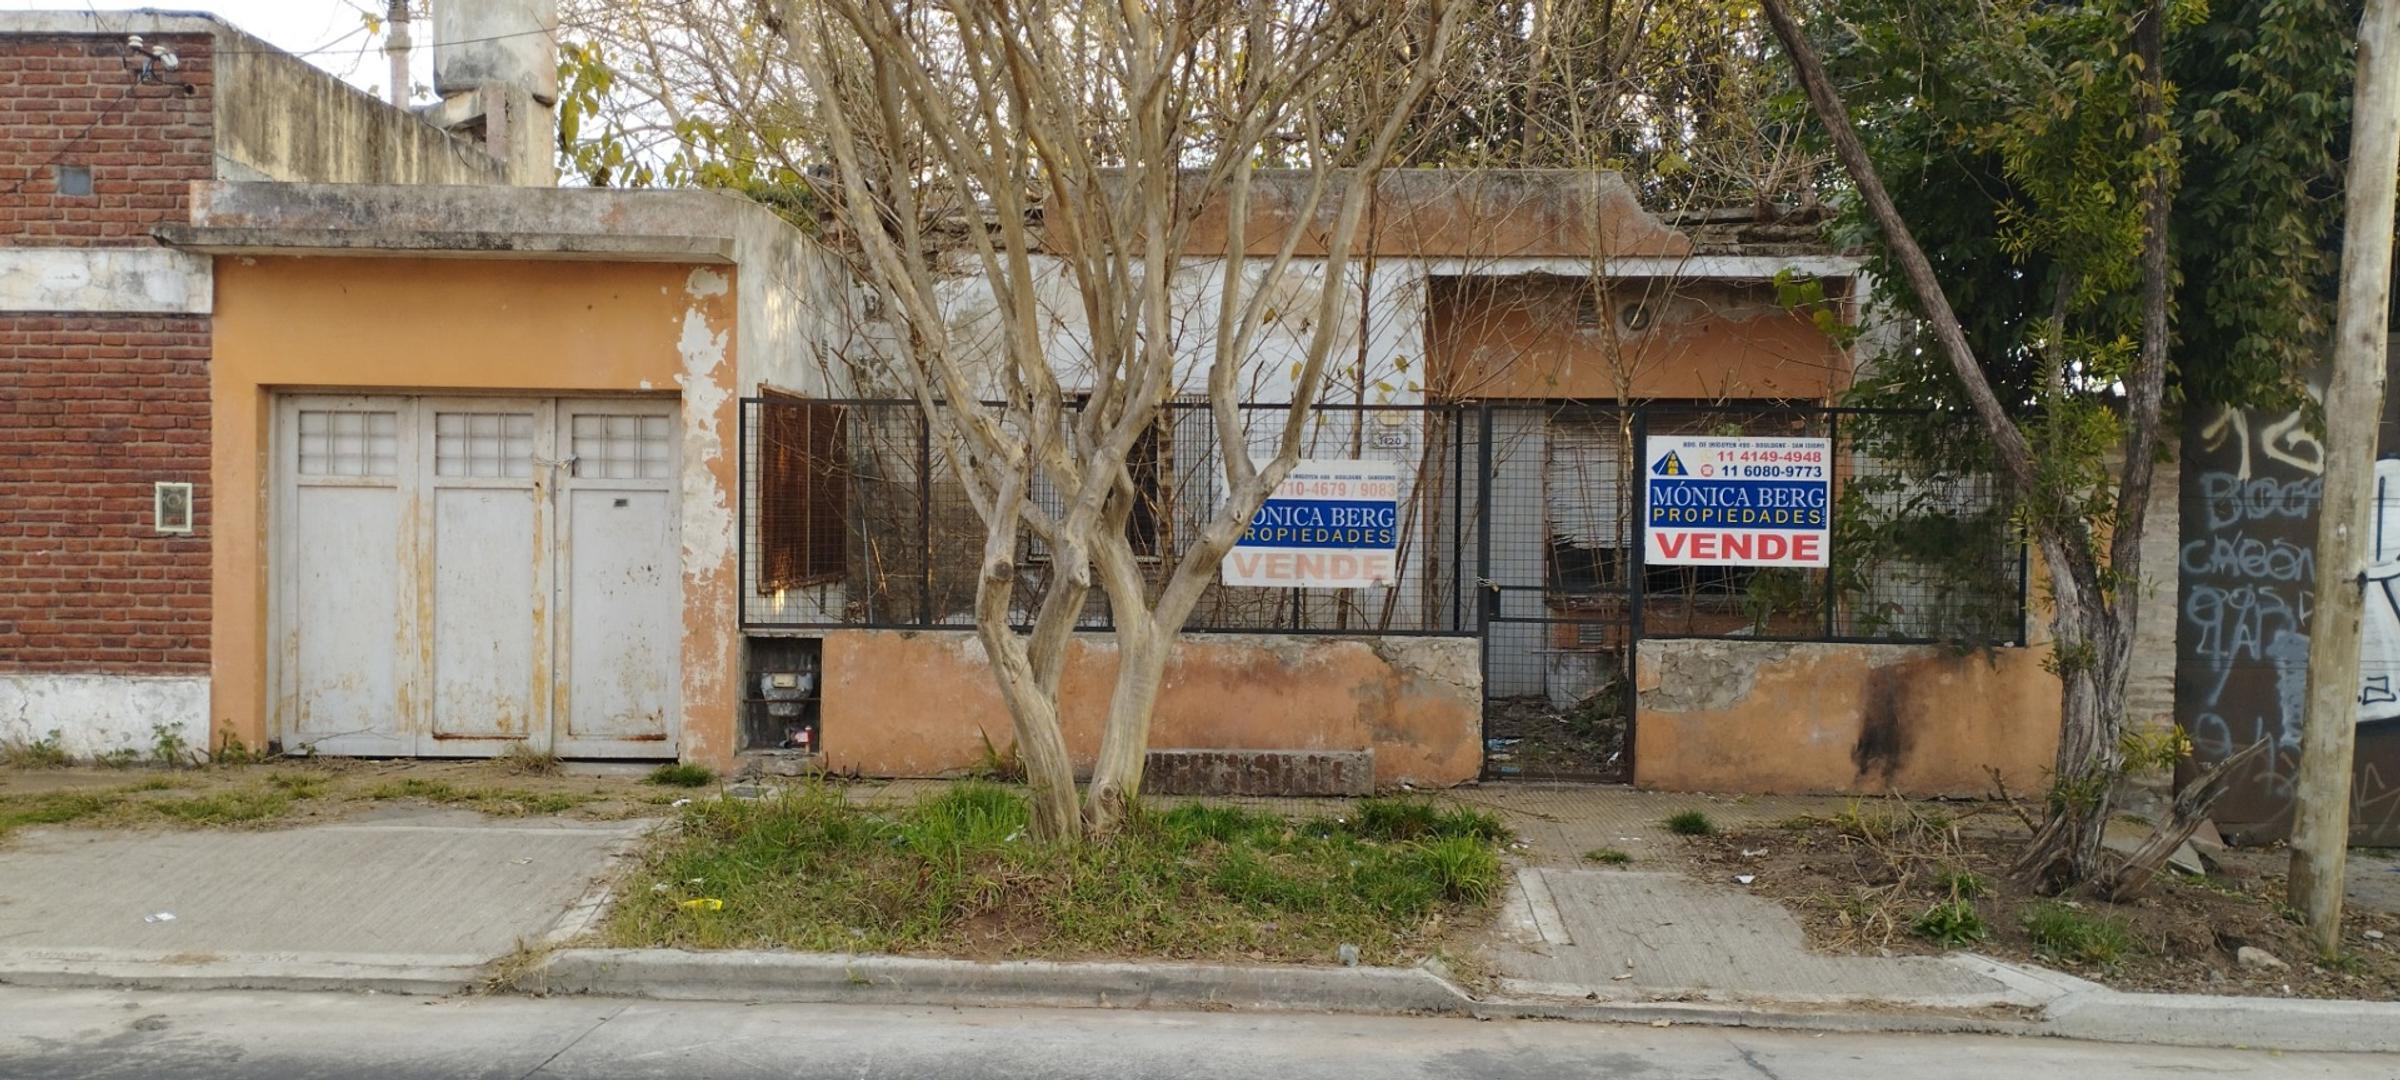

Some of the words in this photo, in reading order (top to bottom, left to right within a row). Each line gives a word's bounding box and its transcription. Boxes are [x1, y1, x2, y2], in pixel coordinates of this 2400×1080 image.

[1717, 451, 1734, 462] 11
[1740, 451, 1822, 462] 4149-4948
[1722, 465, 1738, 476] 11
[1744, 465, 1822, 478] 6080-9773
[1279, 482, 1346, 496] 710-4679
[1360, 482, 1396, 497] 9083
[1652, 481, 1751, 507] MÓNICA
[1757, 488, 1825, 508] BERG
[1250, 506, 1324, 526] ONICA
[1330, 507, 1395, 528] BERG
[1653, 508, 1821, 524] PROPIEDADES
[1244, 528, 1391, 544] ROPIEDADES
[1655, 533, 1820, 561] VENDE
[1232, 552, 1390, 581] VENDE
